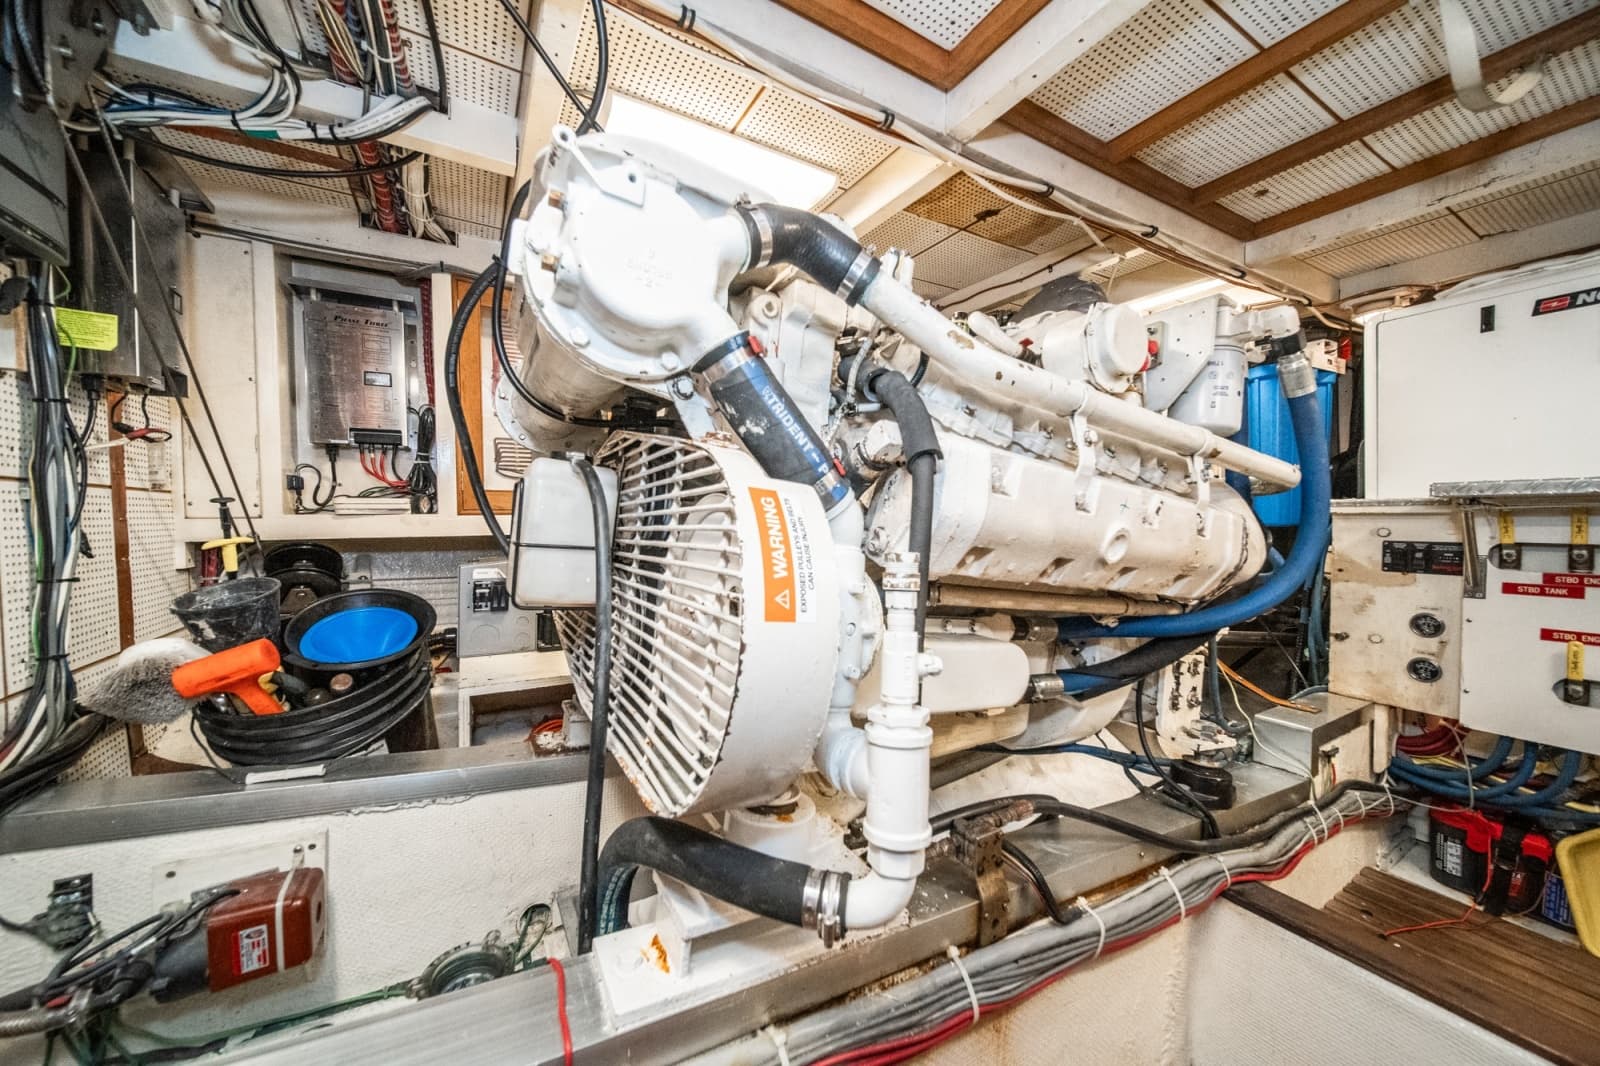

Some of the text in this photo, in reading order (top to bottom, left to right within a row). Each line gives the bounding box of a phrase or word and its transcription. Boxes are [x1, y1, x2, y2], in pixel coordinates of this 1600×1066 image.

[766, 395, 814, 452] TRIDENT
[784, 498, 794, 517] BELTS
[790, 518, 798, 534] AND
[761, 497, 789, 579] WARNING
[794, 535, 804, 570] PULLEYS
[798, 516, 815, 590] CAN CAUSE INJURY
[1555, 575, 1579, 584] STBD
[1517, 585, 1569, 596] STBD TANK
[1552, 632, 1577, 641] STBD
